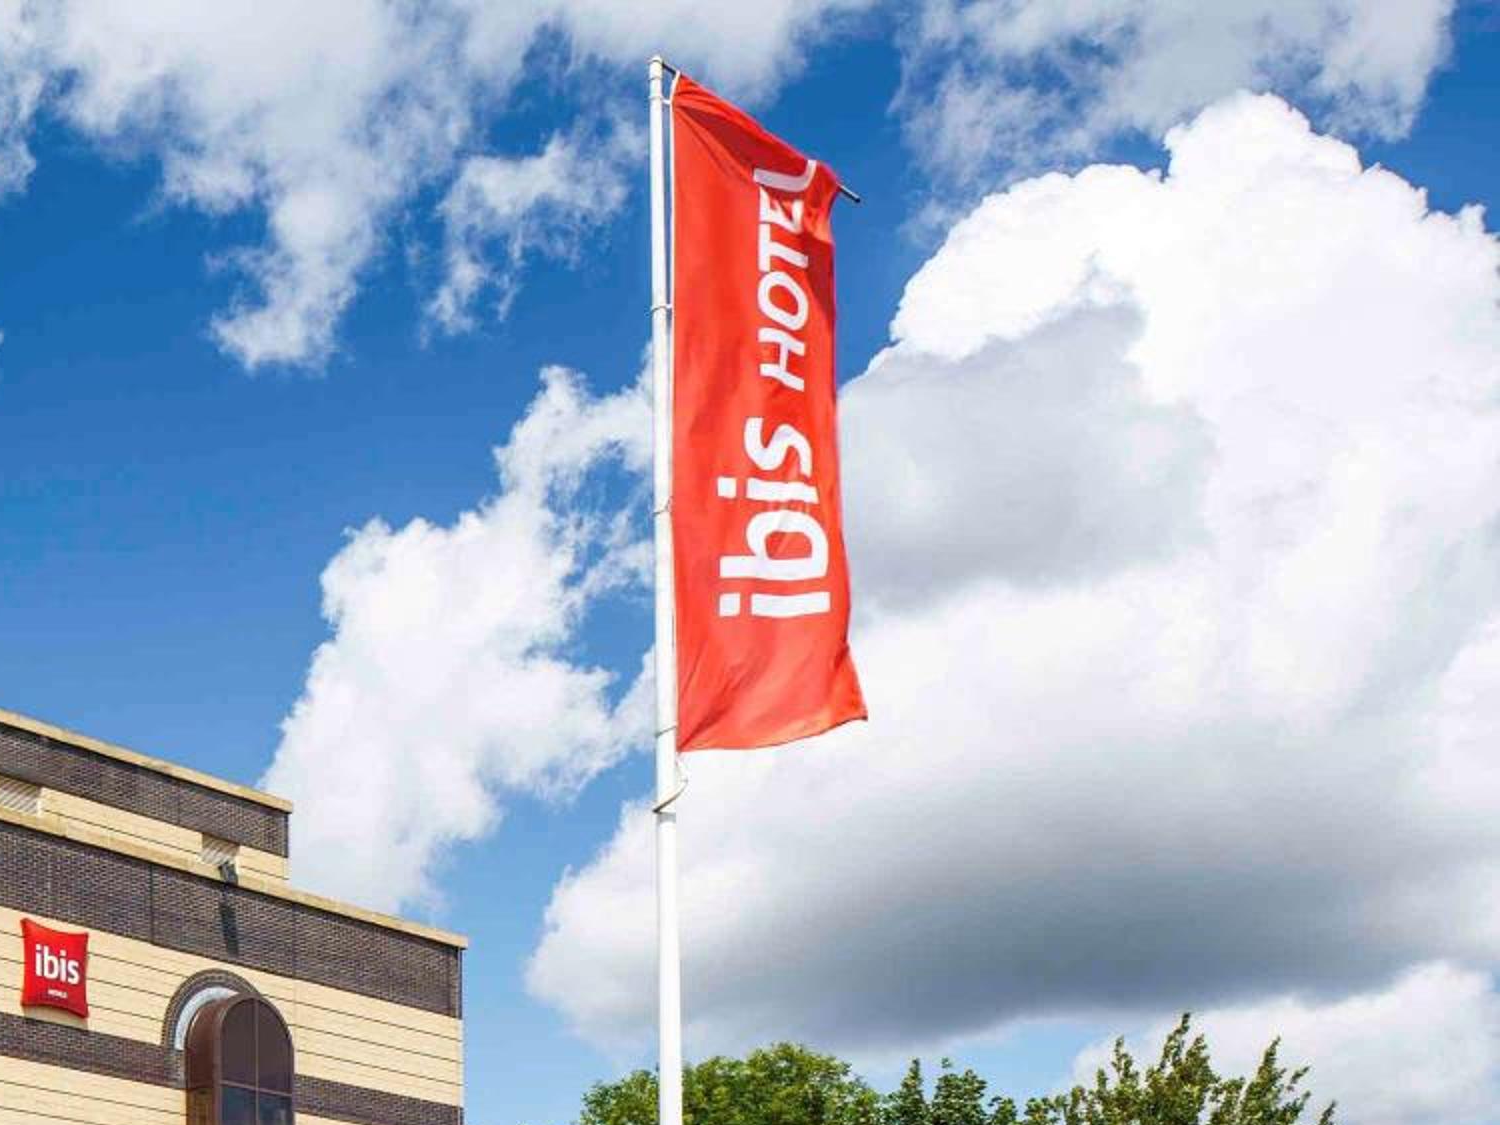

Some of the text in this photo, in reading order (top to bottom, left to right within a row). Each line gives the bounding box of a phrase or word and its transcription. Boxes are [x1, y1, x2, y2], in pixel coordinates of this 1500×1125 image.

[718, 160, 831, 618] ibis HOTEL
[35, 943, 80, 985] ibis
